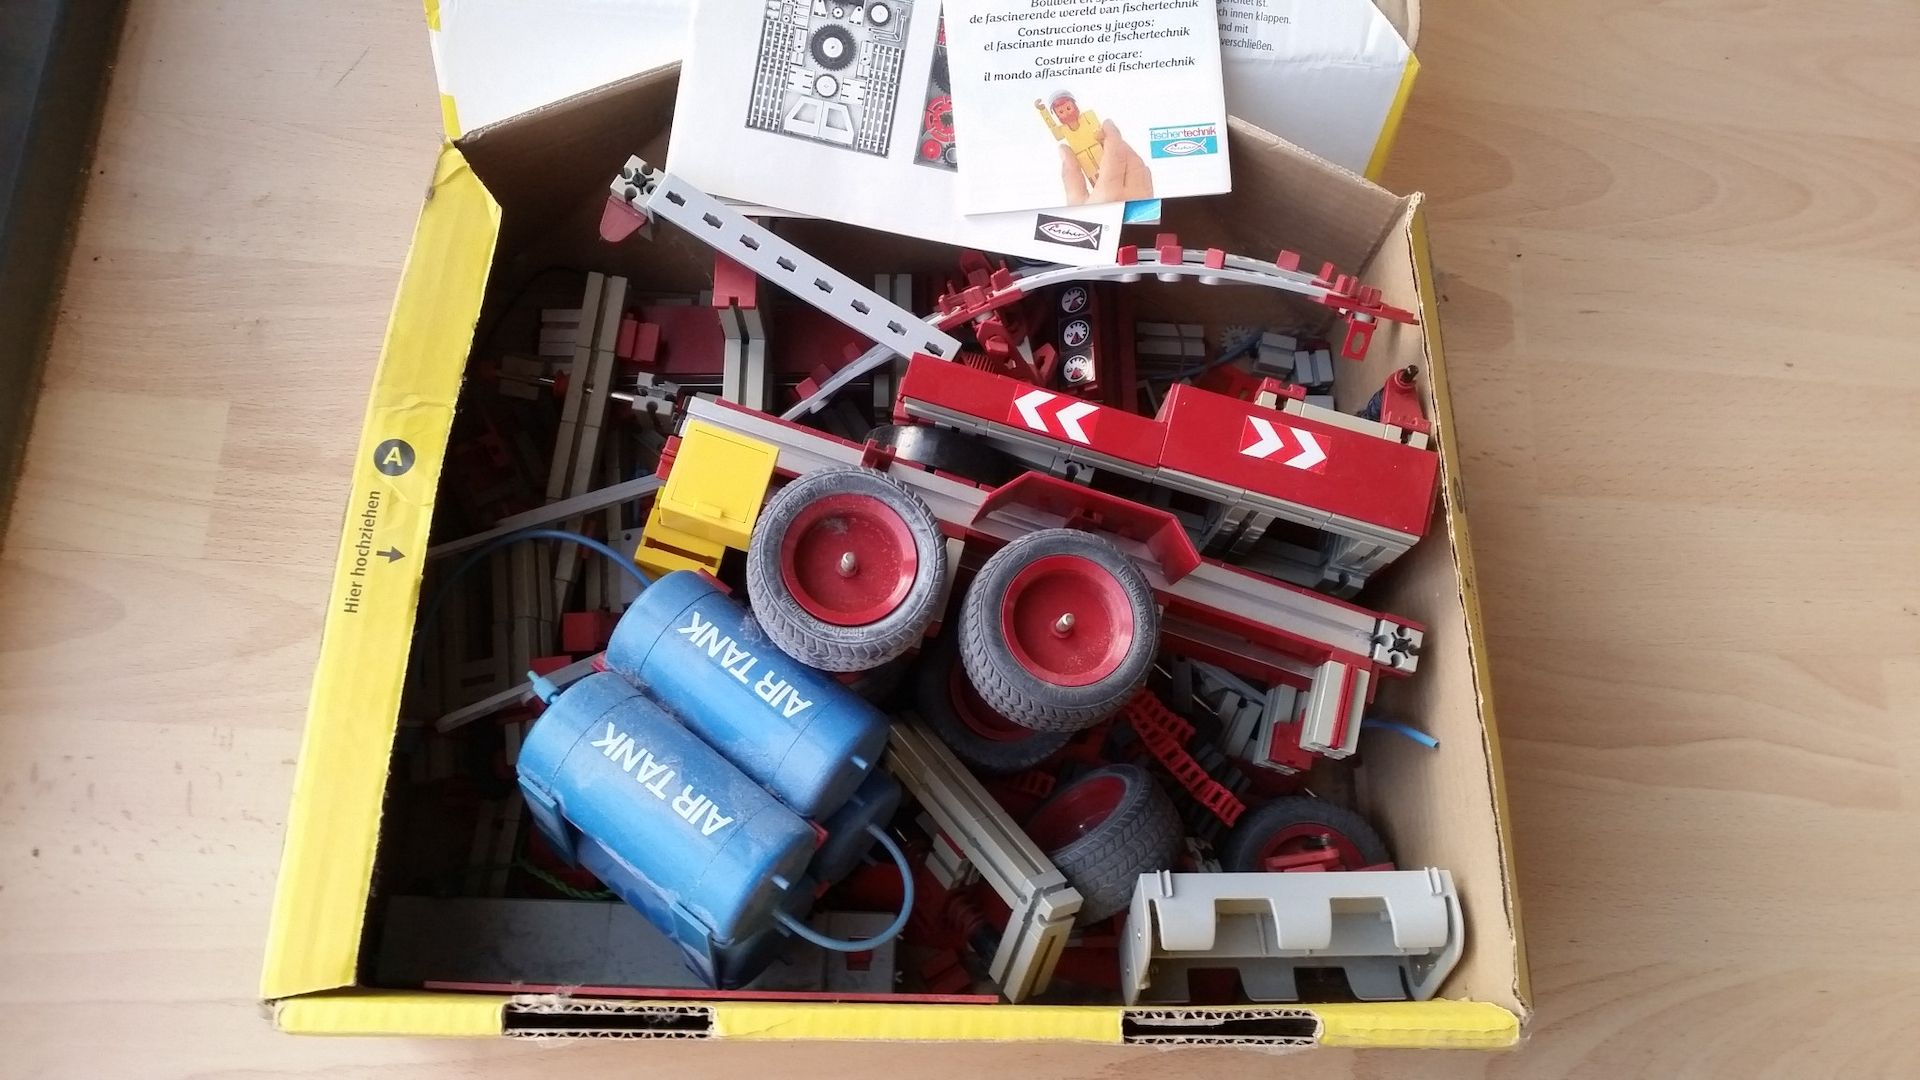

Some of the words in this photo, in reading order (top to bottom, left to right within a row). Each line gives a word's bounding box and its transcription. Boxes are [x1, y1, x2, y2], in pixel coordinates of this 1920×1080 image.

[969, 15, 983, 24] de
[985, 9, 1056, 24] fascinerende
[1059, 5, 1097, 18] wereld
[1099, 6, 1120, 15] van
[1122, 0, 1199, 14] fischertechnik
[1230, 8, 1254, 20] innen
[1255, 11, 1292, 24] klappen.
[983, 41, 994, 51] el
[996, 38, 1054, 52] fascinante
[1056, 35, 1095, 46] mundo
[1097, 33, 1111, 43] de
[1113, 26, 1191, 43] fischertechnik
[1018, 23, 1102, 37] Construcciones
[1105, 24, 1112, 33] y
[1112, 19, 1155, 32] juegos:
[1234, 23, 1248, 34] mit
[1220, 38, 1274, 51] verschließen.
[984, 72, 991, 82] il
[994, 70, 1032, 81] mondo
[1034, 65, 1103, 79] affascinante
[1105, 62, 1116, 72] di
[1118, 56, 1196, 73] fischertechnik
[1035, 54, 1085, 66] Costruire
[1088, 54, 1095, 62] e
[1097, 50, 1143, 63] giocare:
[1150, 126, 1216, 140] fischertechnik
[382, 446, 403, 467] A
[350, 490, 381, 577] hochziehen
[344, 581, 363, 613] Hier
[677, 611, 759, 685] TANK
[754, 669, 813, 720] AIR
[590, 721, 676, 801] TANK
[671, 784, 734, 837] AIR
